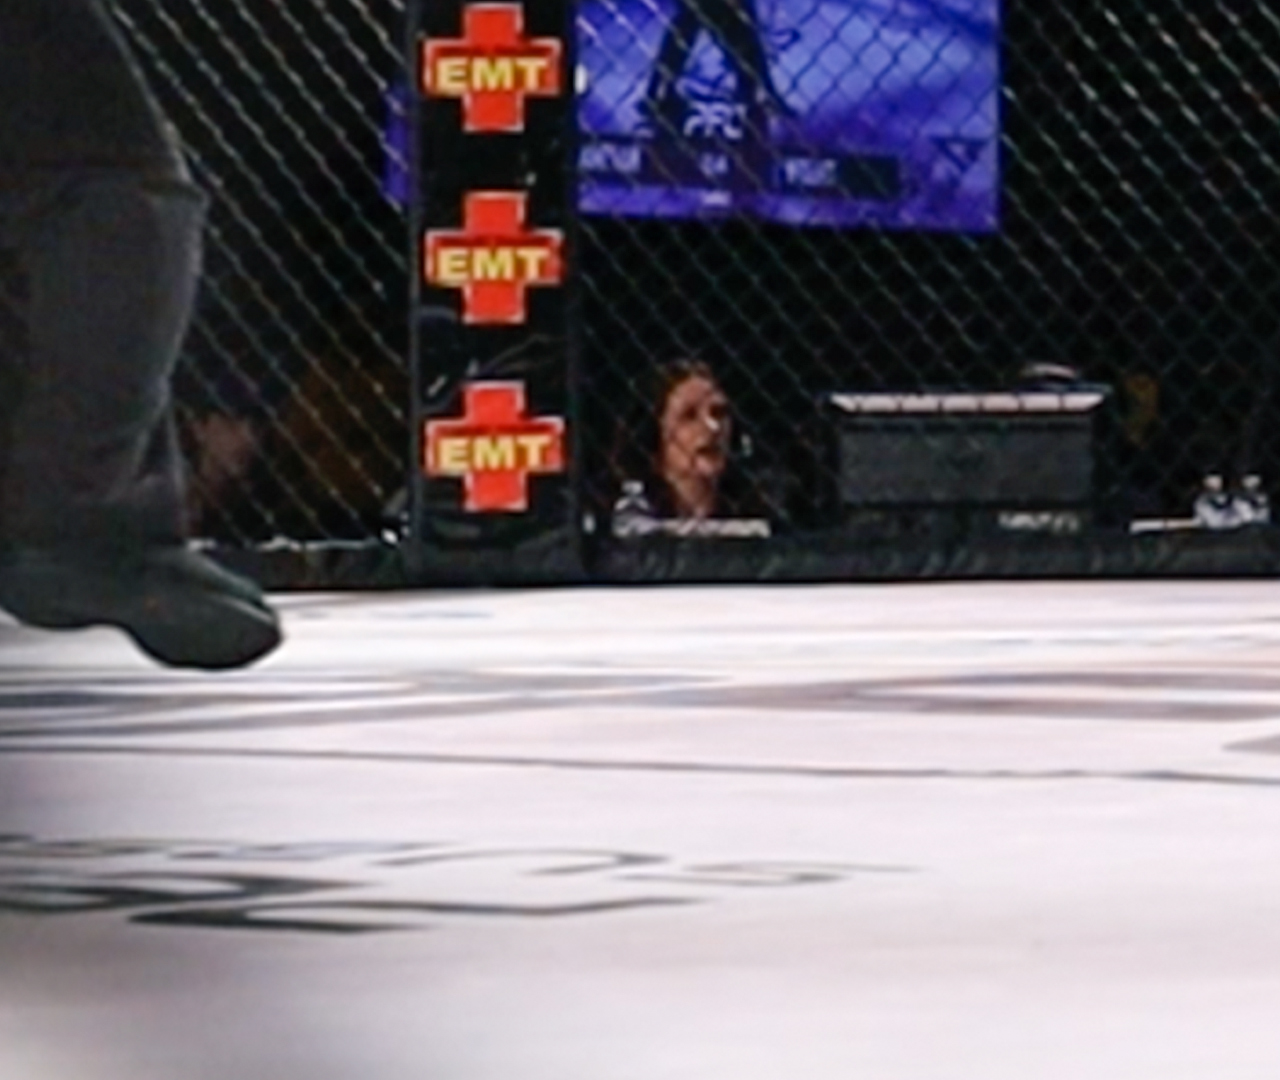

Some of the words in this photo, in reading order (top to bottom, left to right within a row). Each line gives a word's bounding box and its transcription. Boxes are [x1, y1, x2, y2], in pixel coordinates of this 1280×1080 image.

[436, 58, 548, 93] EMT
[437, 248, 549, 284] EMT
[438, 435, 551, 472] EMT
